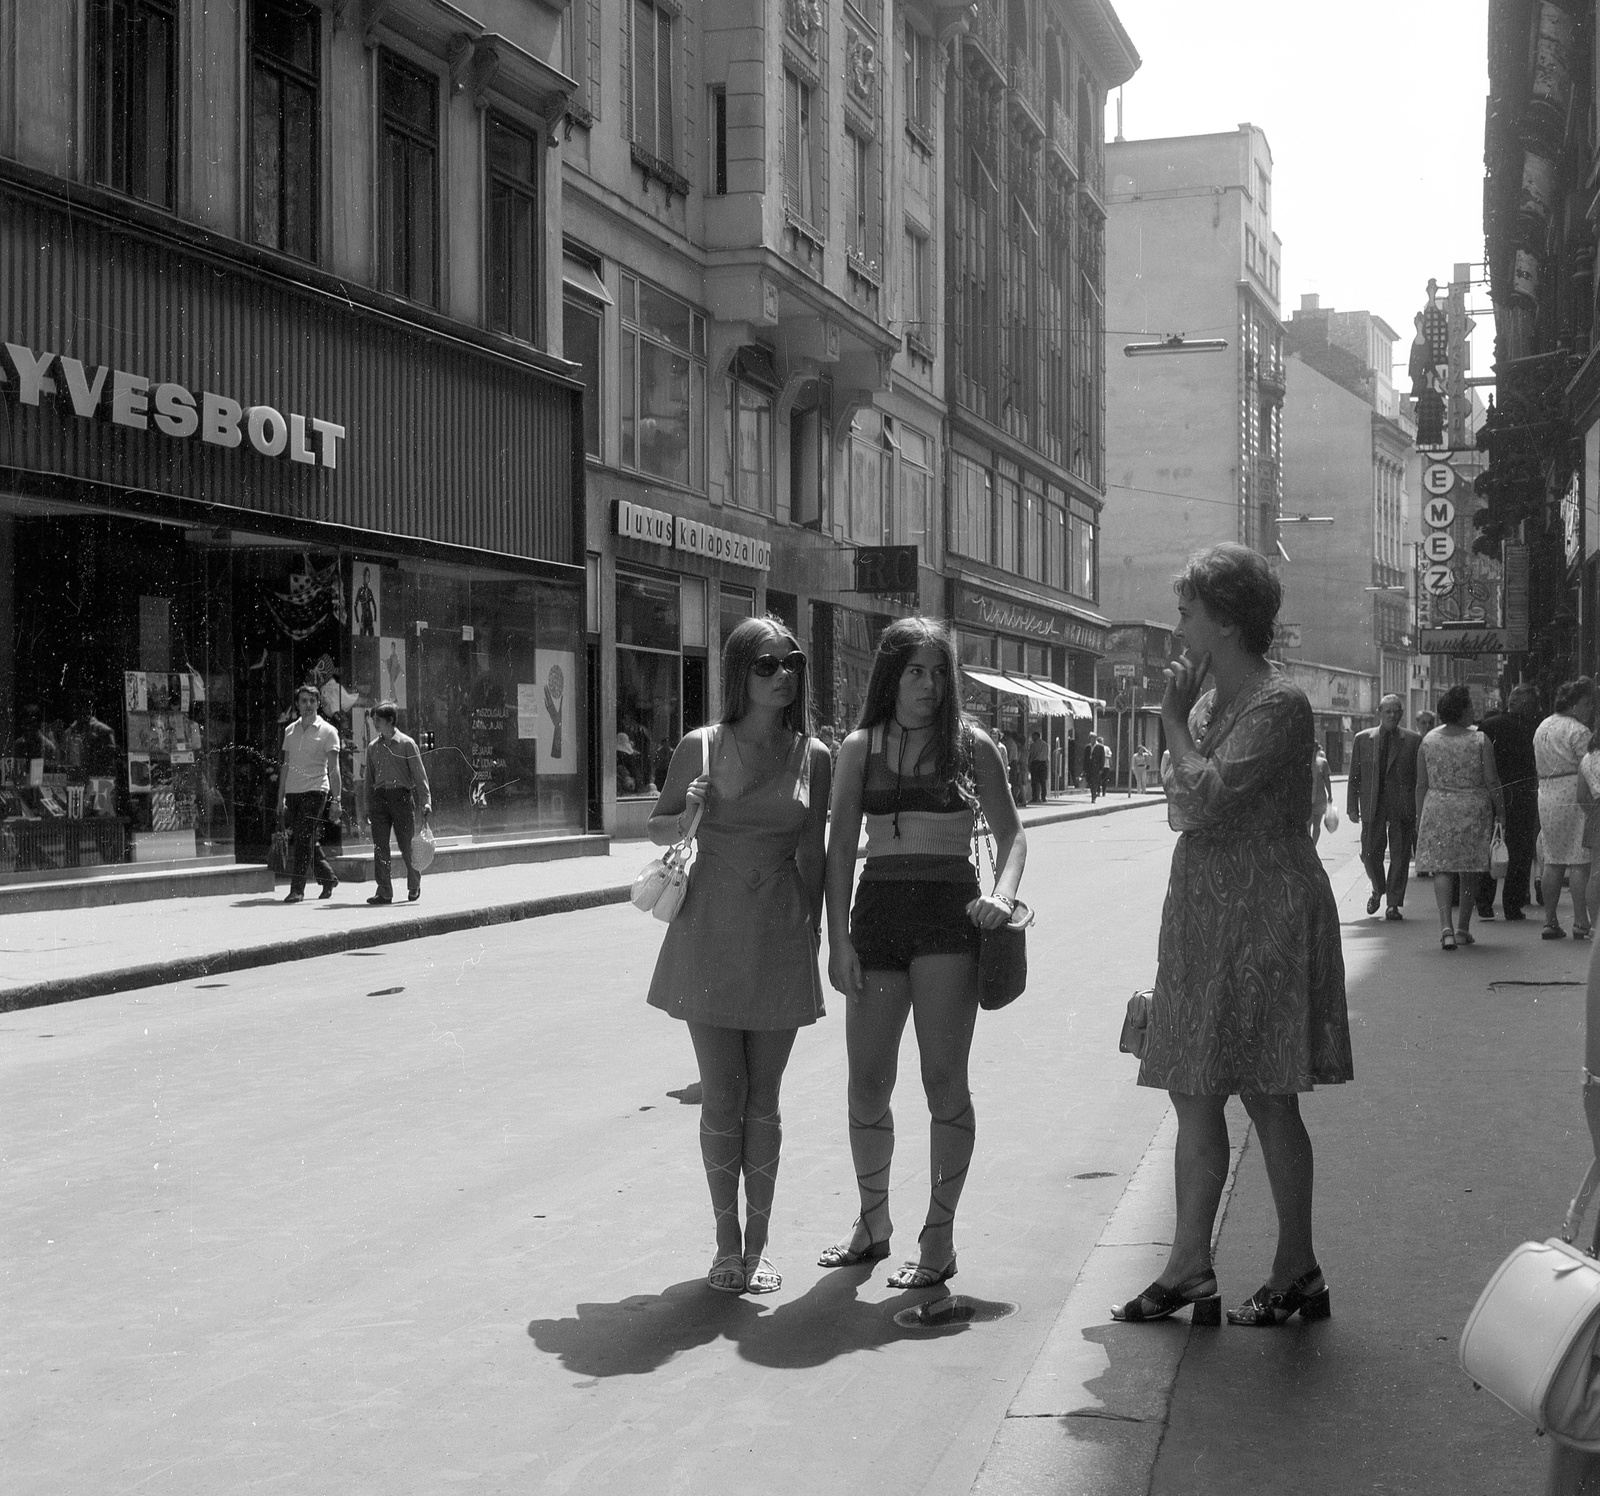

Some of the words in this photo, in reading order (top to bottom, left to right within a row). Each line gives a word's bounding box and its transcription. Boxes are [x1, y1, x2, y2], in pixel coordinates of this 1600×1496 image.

[2, 341, 346, 470] YVESBOLT
[626, 506, 672, 541] luxus
[680, 521, 771, 566] kalapszalon
[1428, 466, 1451, 592] EMEZ
[471, 706, 509, 719] ISZOLGÁLÁS
